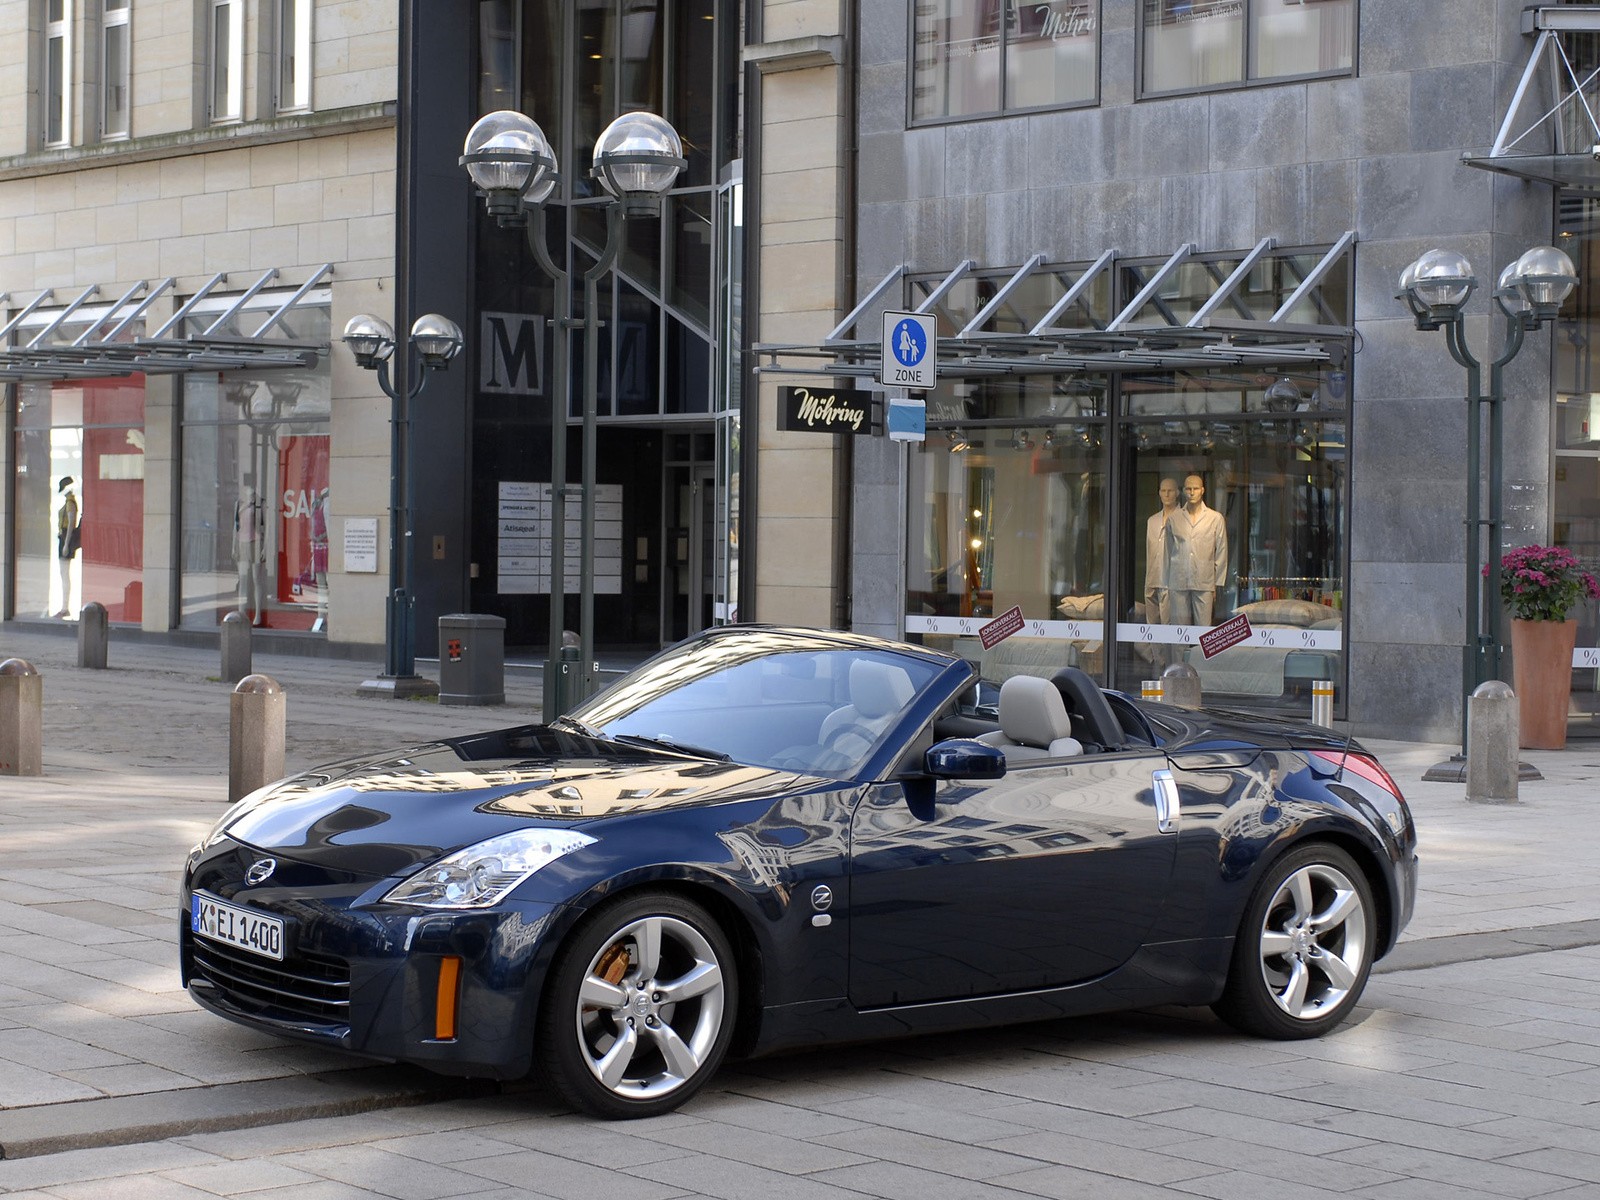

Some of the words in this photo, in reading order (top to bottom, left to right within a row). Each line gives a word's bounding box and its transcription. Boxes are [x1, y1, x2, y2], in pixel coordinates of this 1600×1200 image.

[486, 317, 539, 389] M
[895, 370, 922, 382] ZONE
[794, 388, 864, 431] Möhring
[981, 610, 1018, 636] SONDERVERKAUF
[1202, 618, 1244, 644] SONDERVERKAUF
[200, 902, 208, 932] K
[240, 916, 279, 954] 1400
